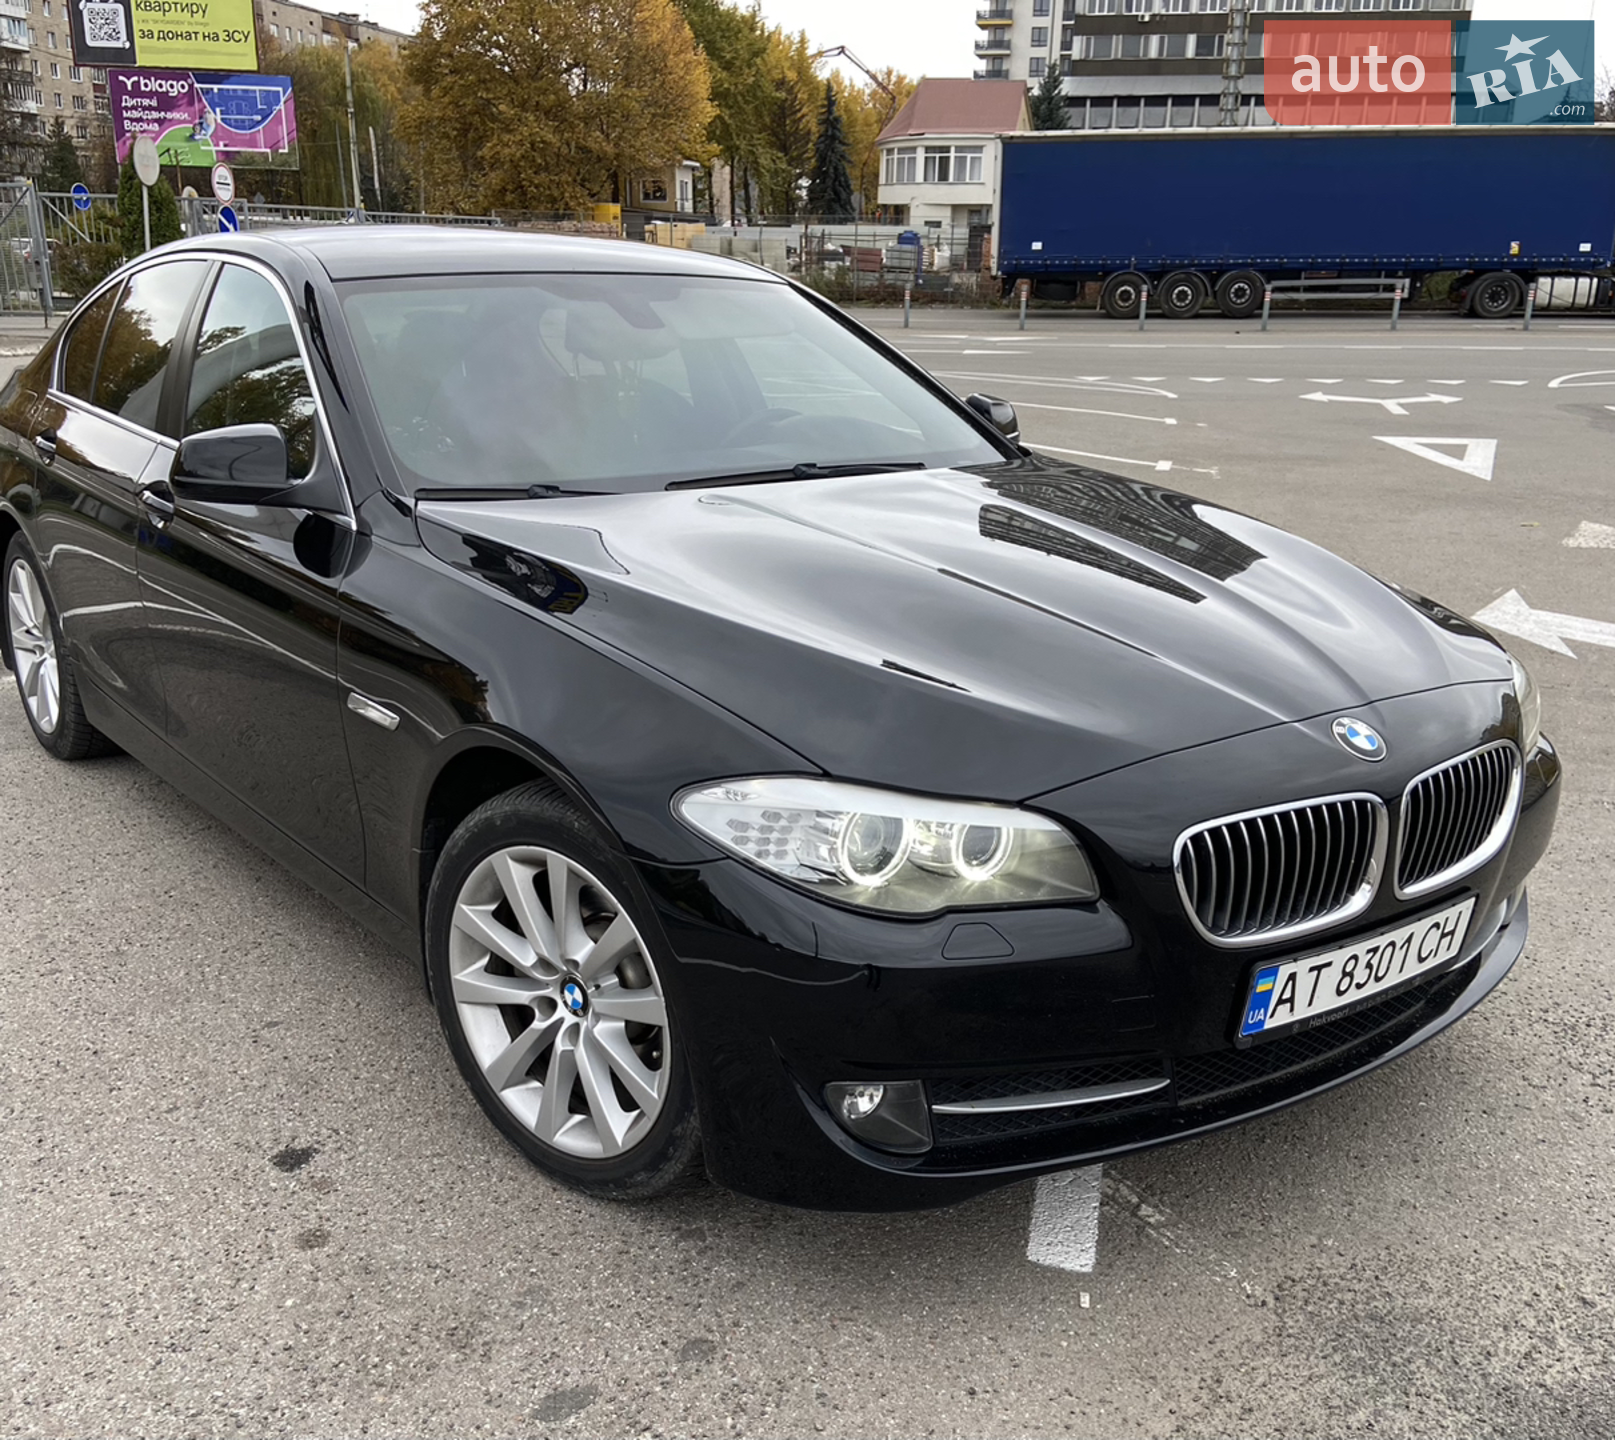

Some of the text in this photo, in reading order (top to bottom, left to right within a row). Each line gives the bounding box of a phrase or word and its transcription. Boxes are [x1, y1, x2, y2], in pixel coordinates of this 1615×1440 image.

[135, 0, 208, 18] квартиру
[138, 29, 251, 43] за донат на ЗСУ
[140, 75, 189, 96] blago
[1269, 960, 1332, 1019] AT
[1335, 932, 1414, 997] 8301
[1417, 910, 1463, 964] CH
[1248, 1008, 1265, 1024] UA
